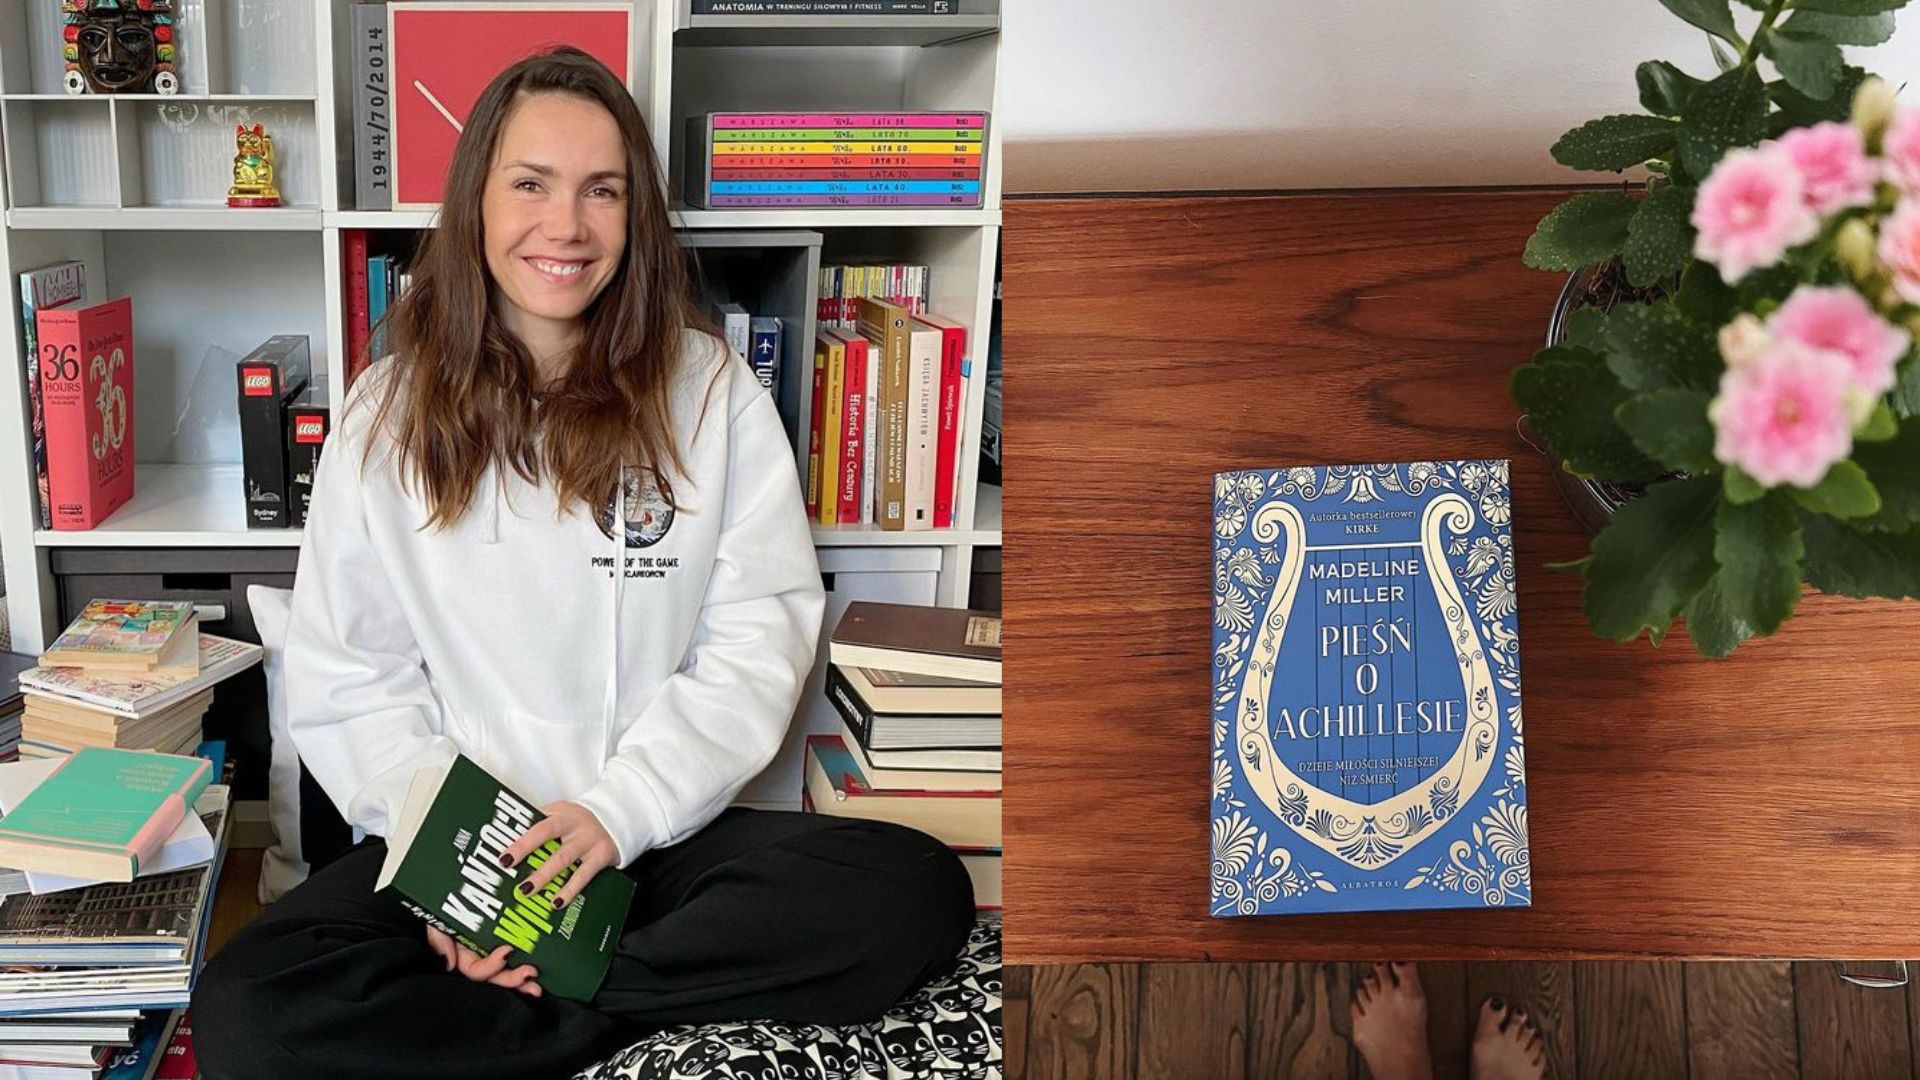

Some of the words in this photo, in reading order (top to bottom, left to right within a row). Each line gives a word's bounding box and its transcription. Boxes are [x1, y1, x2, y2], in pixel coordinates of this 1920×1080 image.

[366, 26, 388, 189] 1944/70/2014
[43, 344, 79, 380] 36
[922, 358, 930, 385] KSIĘGA
[45, 383, 80, 392] HOURS
[246, 376, 269, 387] LEGO
[848, 394, 861, 436] Historia
[920, 388, 930, 436] ZACHWYTÓW
[299, 423, 321, 434] LEGO
[848, 440, 858, 457] Bez
[844, 462, 858, 501] Cenzury
[253, 508, 278, 518] Sydney
[1310, 511, 1347, 522] Autorka
[1350, 510, 1416, 520] bestsellerowej
[1346, 524, 1380, 534] KIRKE
[592, 557, 614, 567] POWE
[625, 558, 636, 567] OF
[639, 558, 654, 567] THE
[656, 558, 679, 567] GAME
[1309, 560, 1420, 580] MADELINE
[1326, 586, 1404, 604] MILLER
[1322, 617, 1412, 657] PIEŚŃ
[1356, 664, 1378, 695] O
[1273, 700, 1464, 740] ACHILLESIE
[1298, 761, 1333, 772] DZIEJE
[1335, 757, 1379, 770] MIŁOŚCI
[1380, 756, 1439, 769] SILNIEJSZEJ
[1339, 774, 1357, 786] NIŻ
[1360, 773, 1399, 784] ŚMIERĆ
[452, 828, 473, 852] ANNA
[441, 789, 535, 933] KAŃTOCH
[1342, 880, 1399, 889] ALBATROS
[493, 838, 580, 954] WIONA
